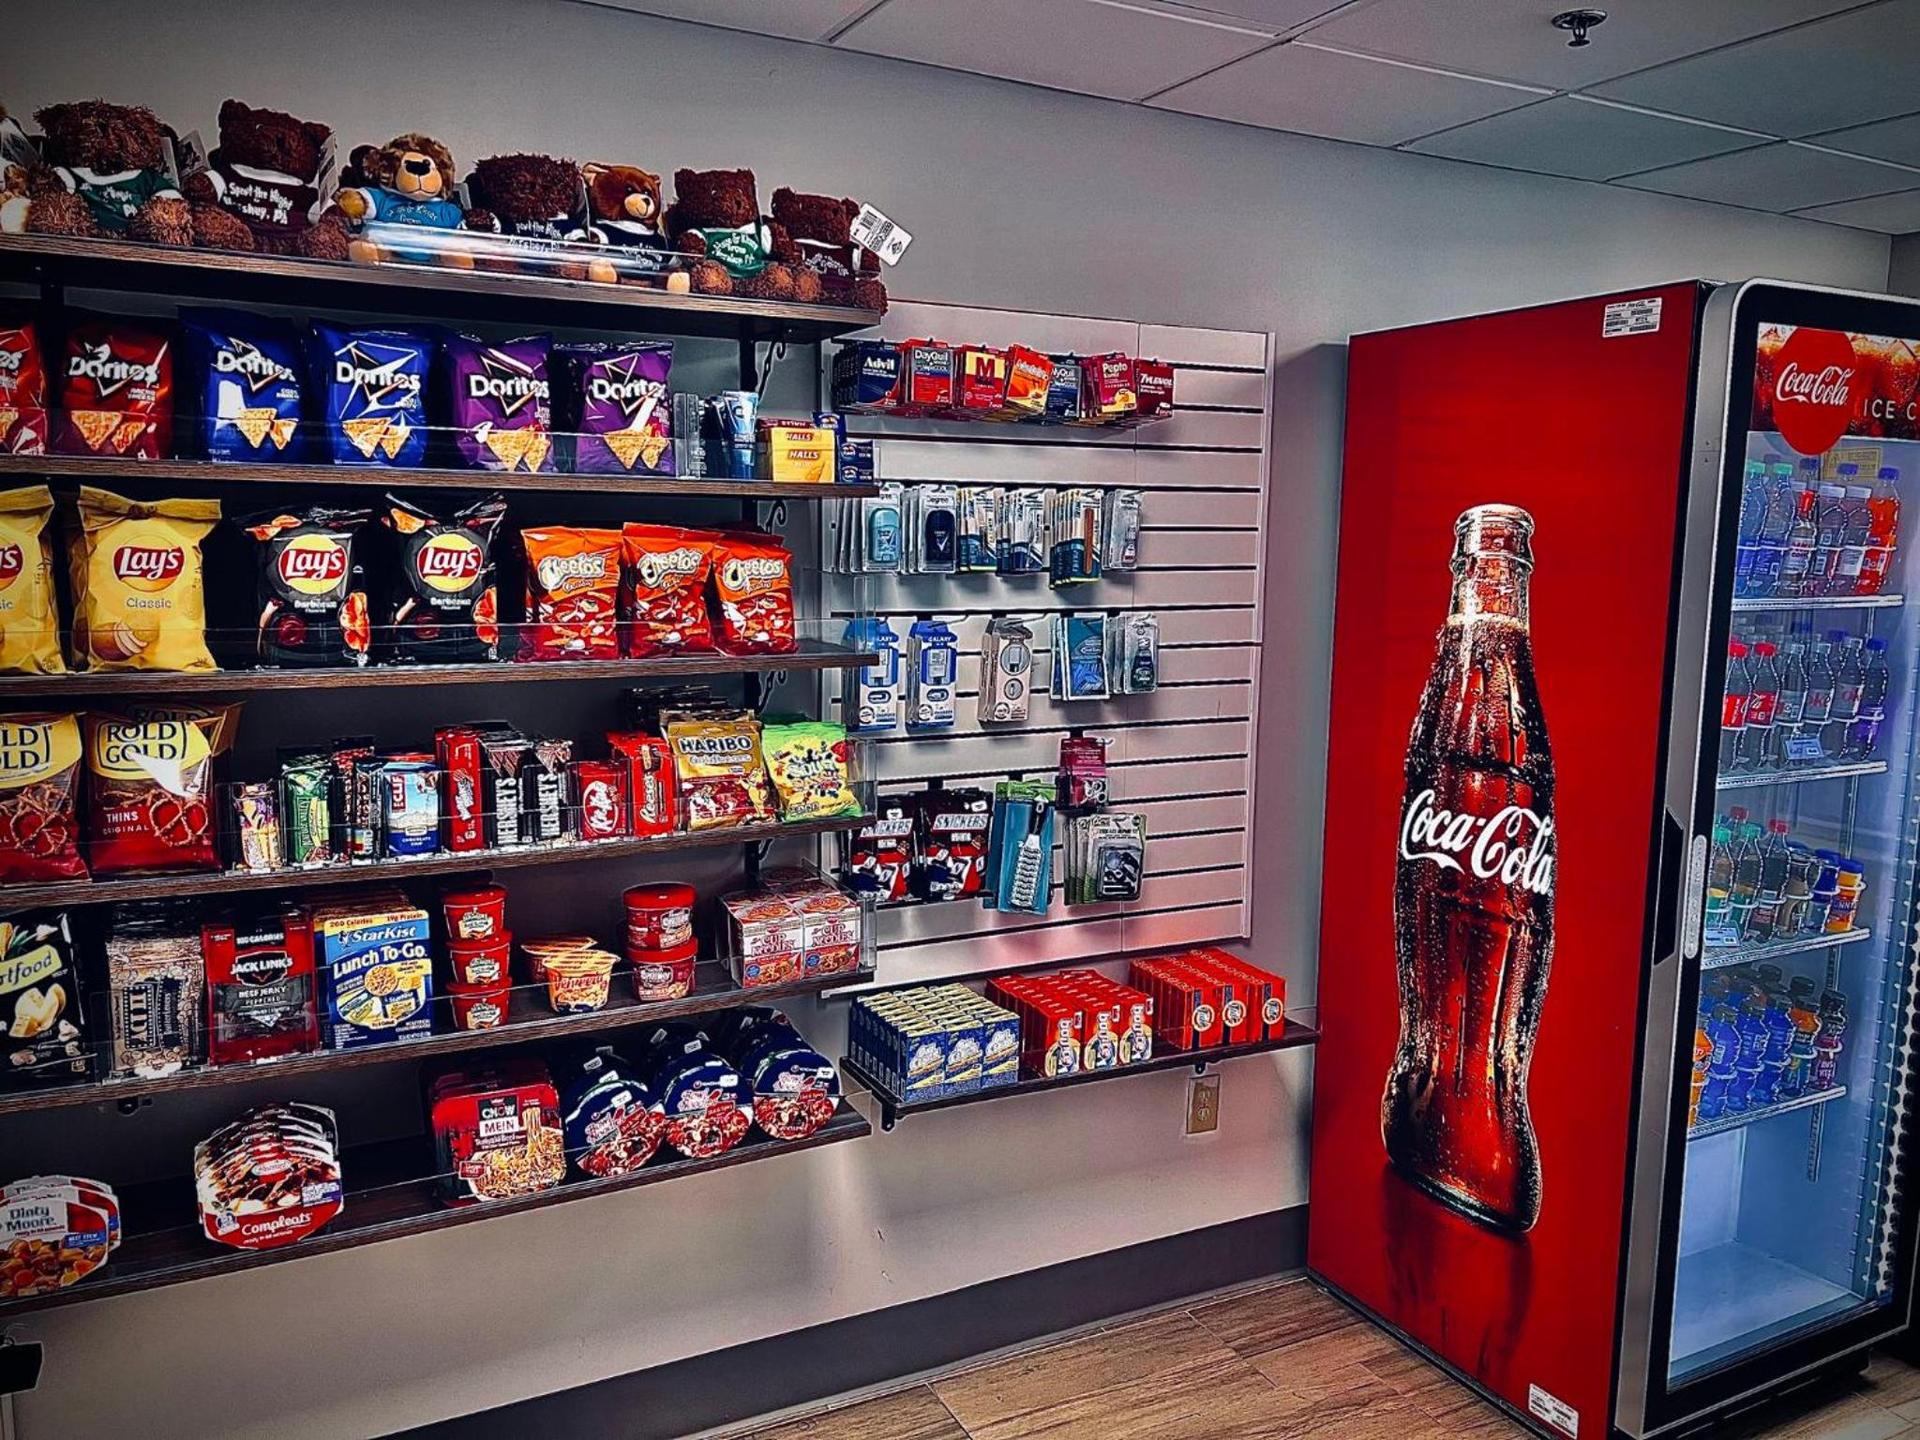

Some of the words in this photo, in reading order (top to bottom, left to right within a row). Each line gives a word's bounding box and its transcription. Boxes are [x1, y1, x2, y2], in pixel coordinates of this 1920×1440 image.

[863, 357, 895, 370] Advil
[915, 350, 948, 362] DayQuil
[68, 356, 158, 383] Doritos
[217, 350, 297, 382] Doritos
[336, 361, 421, 389] Doritos
[1102, 362, 1128, 374] Pepto
[469, 374, 550, 399] Doritos
[1141, 373, 1173, 386] TYLENOL
[1776, 362, 1854, 405] Coca-Cola
[593, 378, 667, 400] Doritos
[1863, 398, 1897, 419] ICE
[786, 432, 814, 442] HALLS
[789, 450, 820, 460] HALLS
[926, 496, 949, 505] Degree
[118, 547, 183, 580] Lay's
[284, 547, 344, 580] Lay's
[422, 545, 479, 579] Lay's
[637, 548, 702, 588] Cheetos
[539, 554, 605, 590] Cheetos
[723, 559, 784, 590] Cheetos
[126, 598, 172, 609] Classic
[294, 598, 338, 609] Barbecue
[430, 597, 472, 607] Barbecue
[106, 722, 177, 742] ROLD
[105, 744, 177, 763] GOLD
[679, 736, 752, 754] HARIBO
[495, 777, 518, 845] HERSHEY'S
[537, 773, 561, 837] HERSHEY'S
[106, 810, 139, 824] THINS
[934, 814, 989, 830] SNICKERS
[103, 824, 149, 836] ORIGINAL
[1402, 789, 1554, 895] Coca-Cola
[352, 925, 416, 943] StarKist
[230, 961, 260, 974] JACK
[333, 949, 380, 979] Lunch
[239, 989, 260, 998] BEEF
[260, 986, 286, 998] JERKY
[129, 1015, 149, 1042] ACT
[481, 1105, 516, 1119] CHOW
[484, 1119, 515, 1134] MEIN
[9, 1206, 50, 1220] Dinty
[6, 1216, 55, 1231] Moore
[241, 1212, 312, 1235] Compleats
